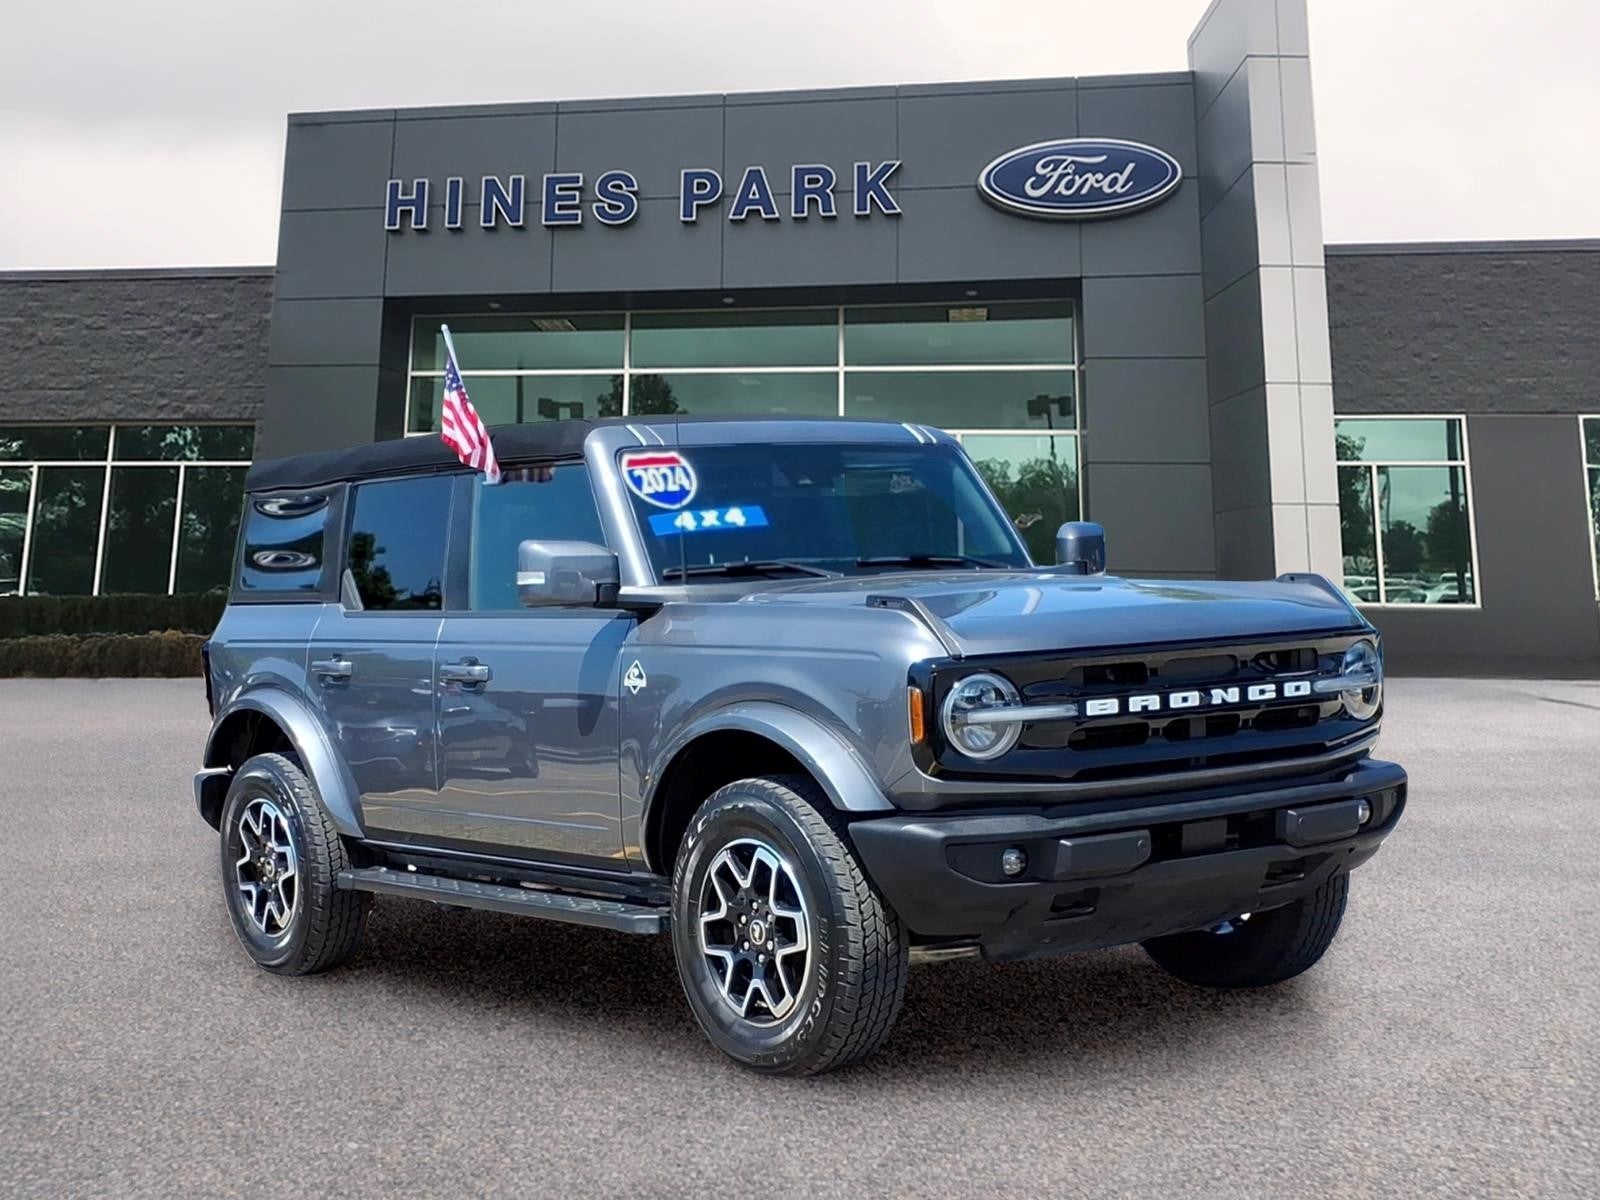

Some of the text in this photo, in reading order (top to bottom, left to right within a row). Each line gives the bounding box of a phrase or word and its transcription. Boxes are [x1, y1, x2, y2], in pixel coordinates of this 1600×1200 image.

[385, 161, 902, 230] HINES PARK
[1024, 155, 1136, 198] Ford
[633, 467, 692, 495] 2024
[1086, 680, 1311, 717] BRONCO
